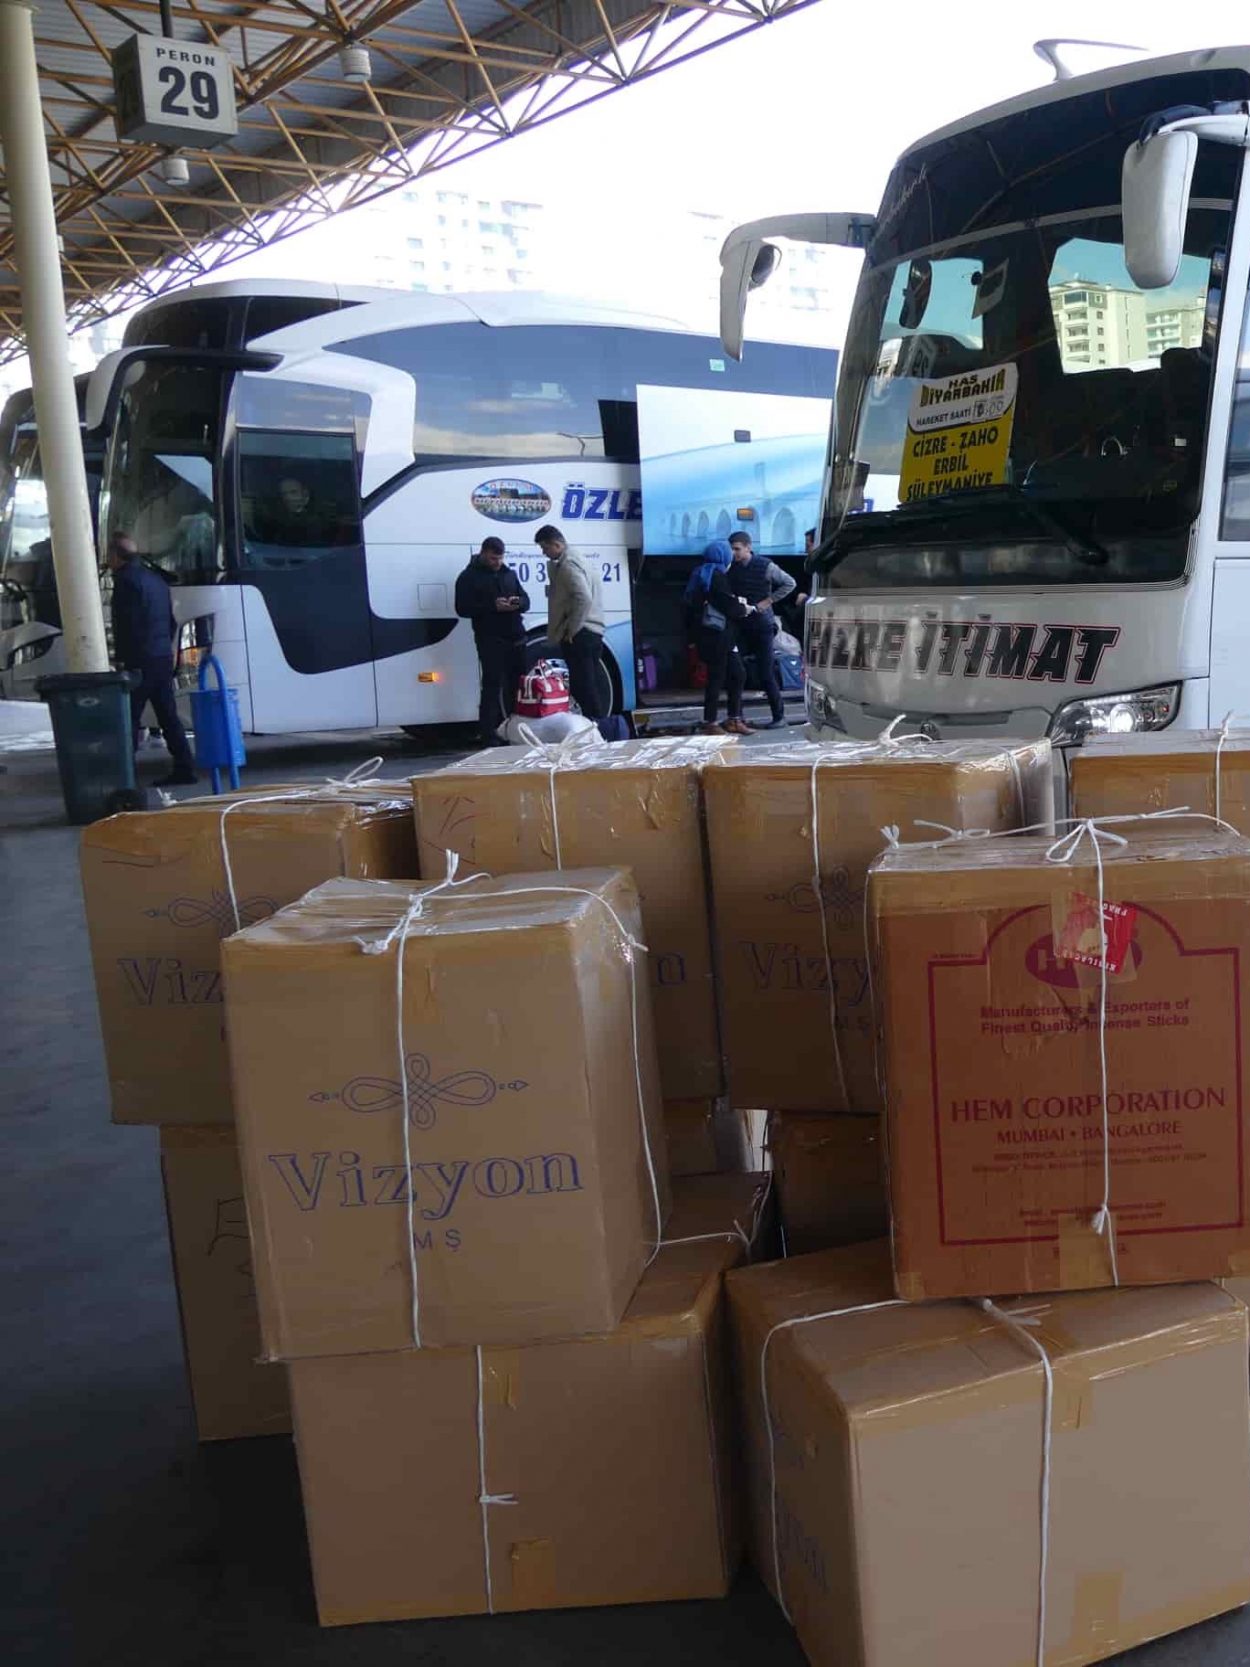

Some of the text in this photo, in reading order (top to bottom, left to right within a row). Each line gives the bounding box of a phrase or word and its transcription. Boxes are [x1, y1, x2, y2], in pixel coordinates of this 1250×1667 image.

[156, 47, 216, 67] PERON
[158, 66, 219, 120] 29
[949, 374, 978, 388] HAS
[913, 433, 946, 458] CİZRE
[960, 427, 998, 450] ZAHO
[933, 452, 969, 475] ERBİL
[906, 470, 993, 501] SÜLEYMANİYE
[915, 611, 1121, 685] İTİMAT
[1105, 1000, 1171, 1016] Exporters
[1175, 998, 1190, 1011] of
[981, 1021, 1025, 1035] Finest
[1086, 1016, 1141, 1031] Inense
[1147, 1014, 1190, 1028] Sticks
[951, 1087, 1226, 1123] HEM CORPORATION
[997, 1121, 1182, 1145] MUMBAI BANGALORE
[268, 1151, 584, 1221] Vizyon
